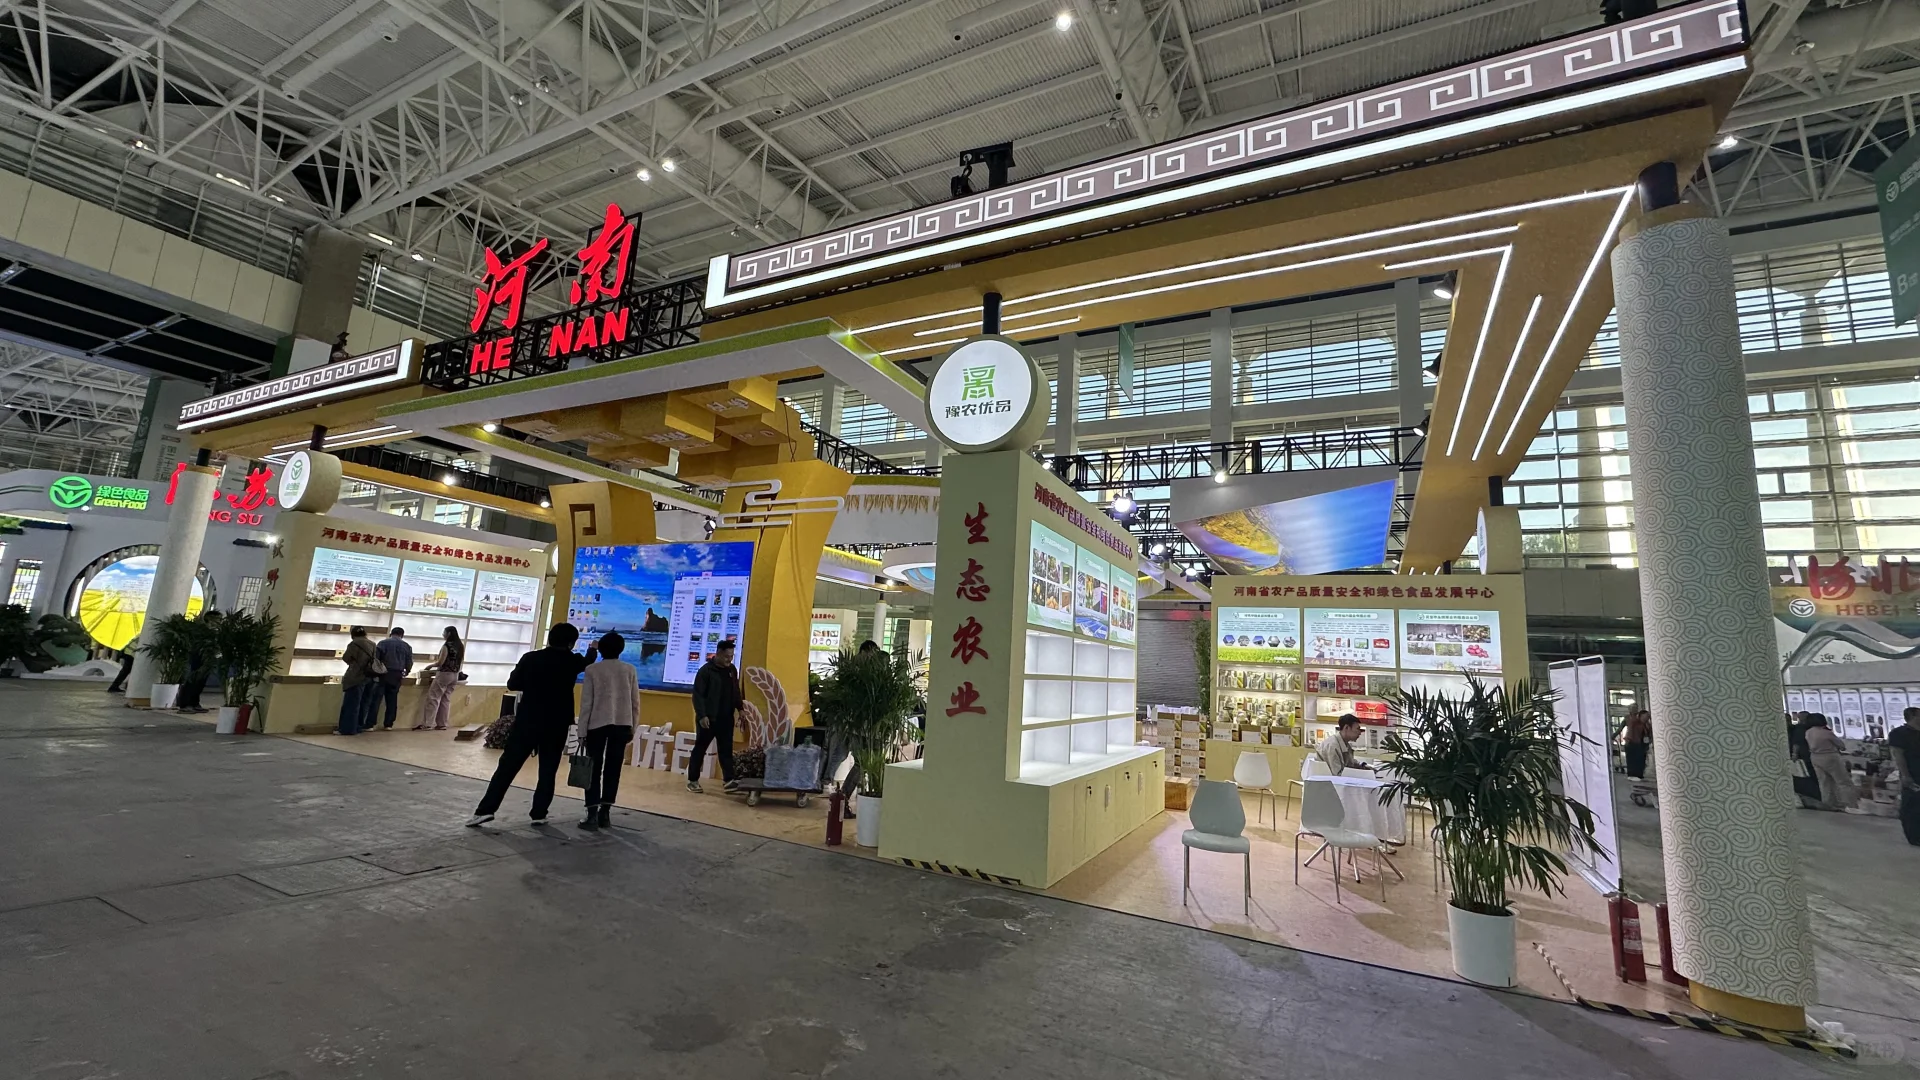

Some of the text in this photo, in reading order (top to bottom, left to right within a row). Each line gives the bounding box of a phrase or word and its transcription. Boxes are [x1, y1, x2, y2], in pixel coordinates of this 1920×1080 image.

[470, 203, 634, 334] 河南
[470, 307, 629, 374] HE NAN
[945, 400, 1011, 418] 豫农优品
[96, 485, 150, 502] 绿色食品
[236, 512, 264, 526] SU
[321, 527, 531, 568] 河南省农产品质量安全和绿色食品发展中心
[1234, 585, 1495, 599] 河南省农产品质量安全和绿色食品发展中心
[944, 502, 991, 718] 生态农业
[1836, 604, 1900, 616] HEBEI
